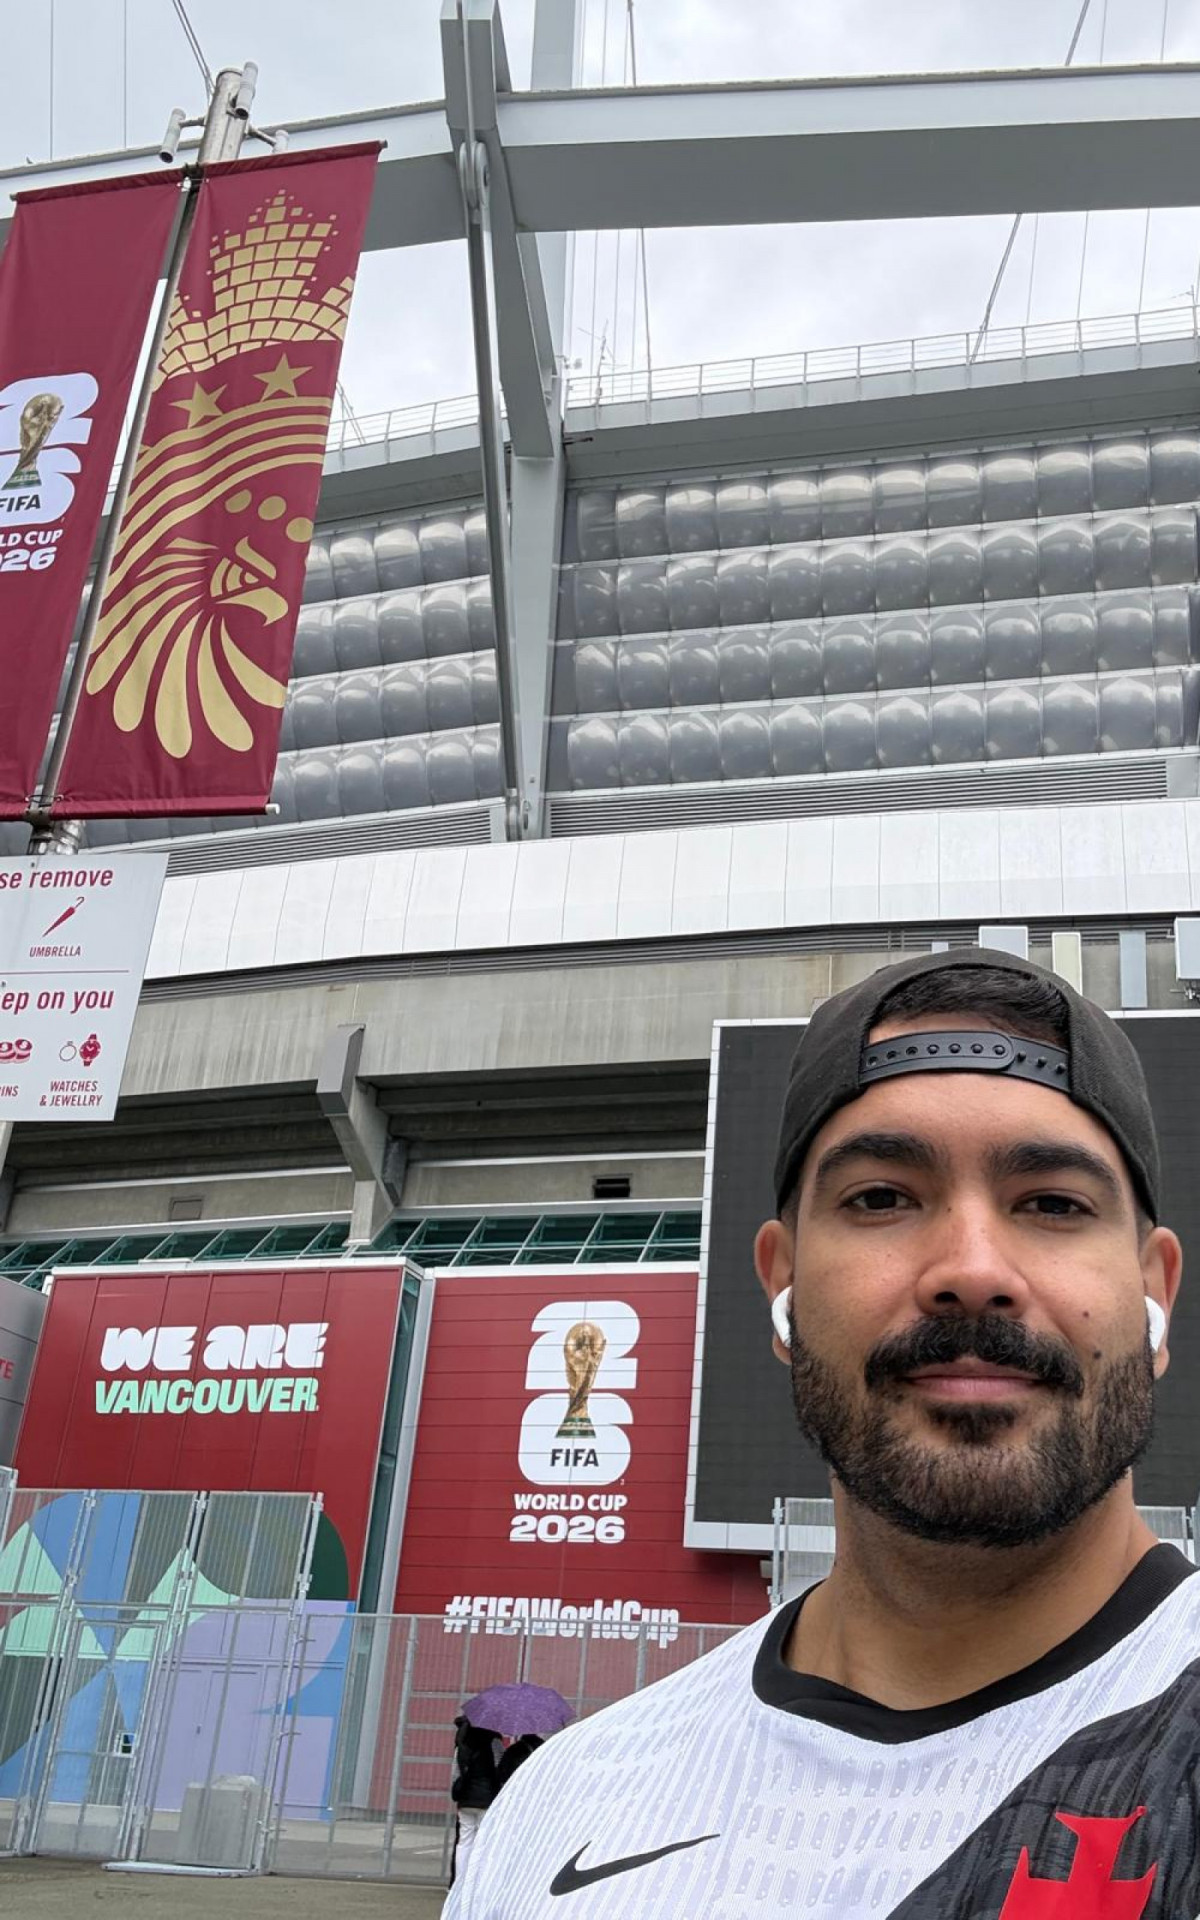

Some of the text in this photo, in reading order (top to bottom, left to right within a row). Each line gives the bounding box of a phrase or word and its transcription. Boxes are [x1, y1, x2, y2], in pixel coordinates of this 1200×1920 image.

[24, 529, 63, 545] CUP
[0, 546, 57, 572] 26
[0, 869, 114, 889] se remove
[29, 945, 81, 958] UMBRELLA
[1, 990, 114, 1015] ep on you
[0, 1085, 19, 1097] INS
[50, 1080, 98, 1092] WATCHES
[39, 1094, 103, 1107] & JEWELLRY
[100, 1326, 198, 1372] WE
[95, 1377, 319, 1414] VANCOUVER
[550, 1448, 599, 1467] FIFA
[514, 1493, 628, 1511] WORLD CUP
[509, 1514, 626, 1544] 2026
[443, 1595, 679, 1649] #FIFAWorldCup
